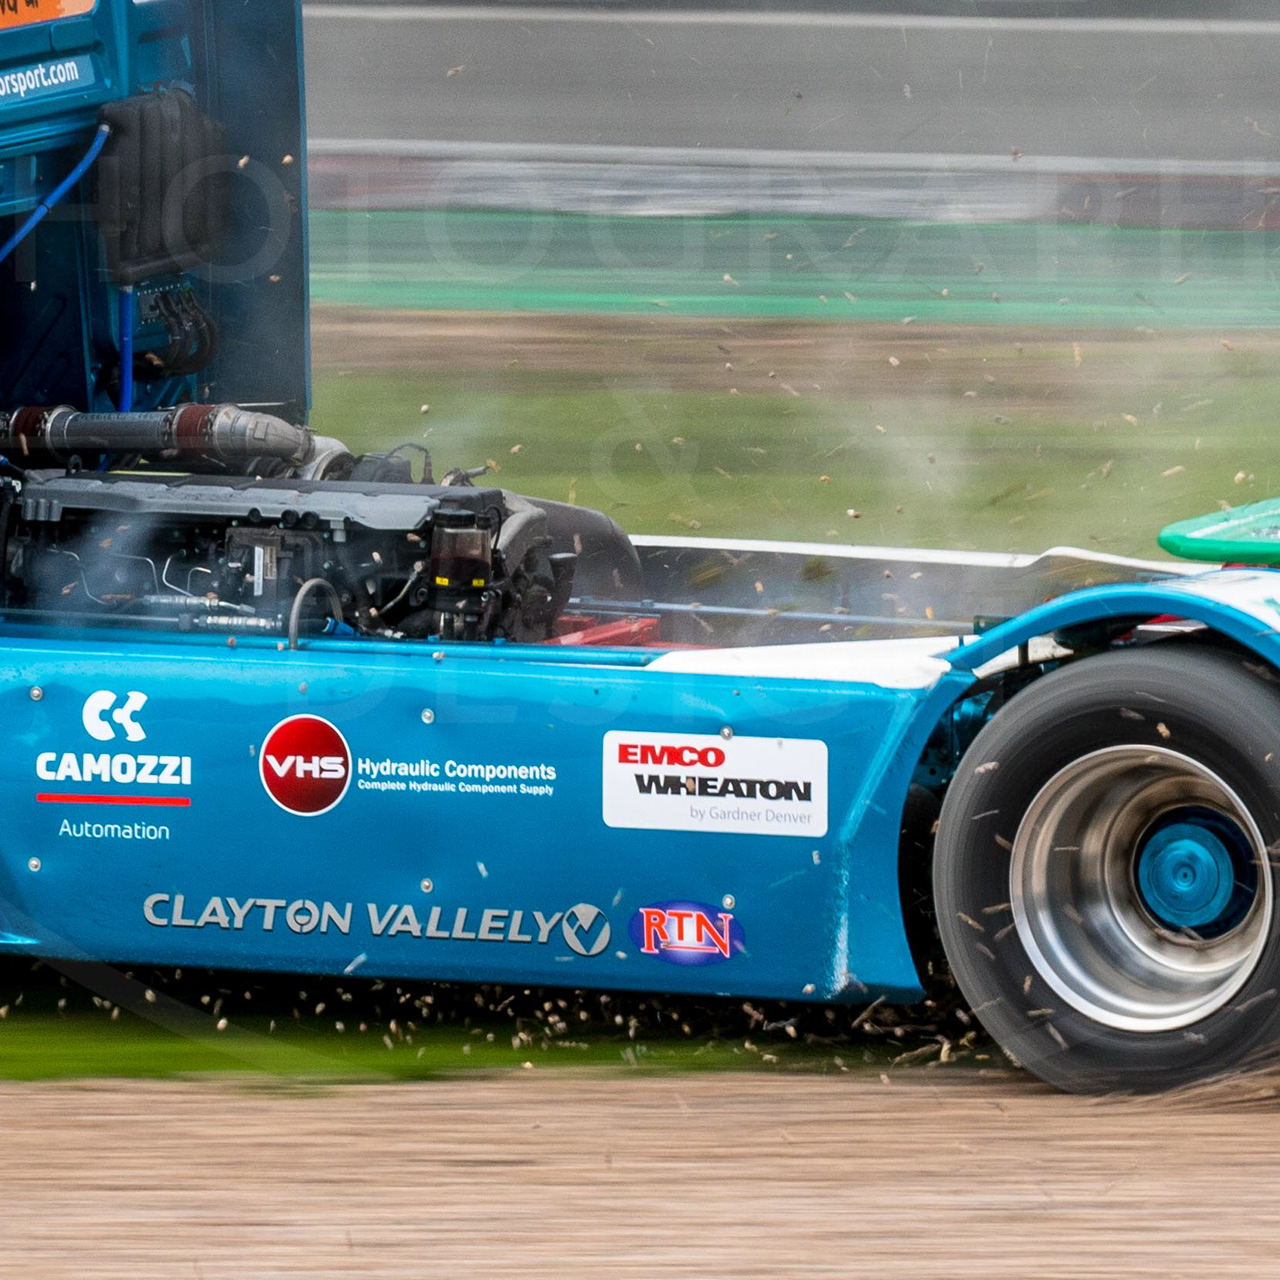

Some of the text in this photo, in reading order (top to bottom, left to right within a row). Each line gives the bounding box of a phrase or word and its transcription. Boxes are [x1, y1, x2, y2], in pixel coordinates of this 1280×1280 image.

[264, 754, 346, 780] VHS
[618, 743, 726, 768] EMCO
[36, 753, 192, 785] CAMOZZI
[358, 757, 557, 784] Hydraulic Components
[357, 779, 554, 795] Complete Hydraulic Component Supply
[635, 773, 812, 802] WHEATON
[690, 806, 812, 824] by Gardner Denver
[58, 819, 170, 841] Automation
[144, 893, 352, 935] CLAYTON
[643, 906, 733, 958] RTN
